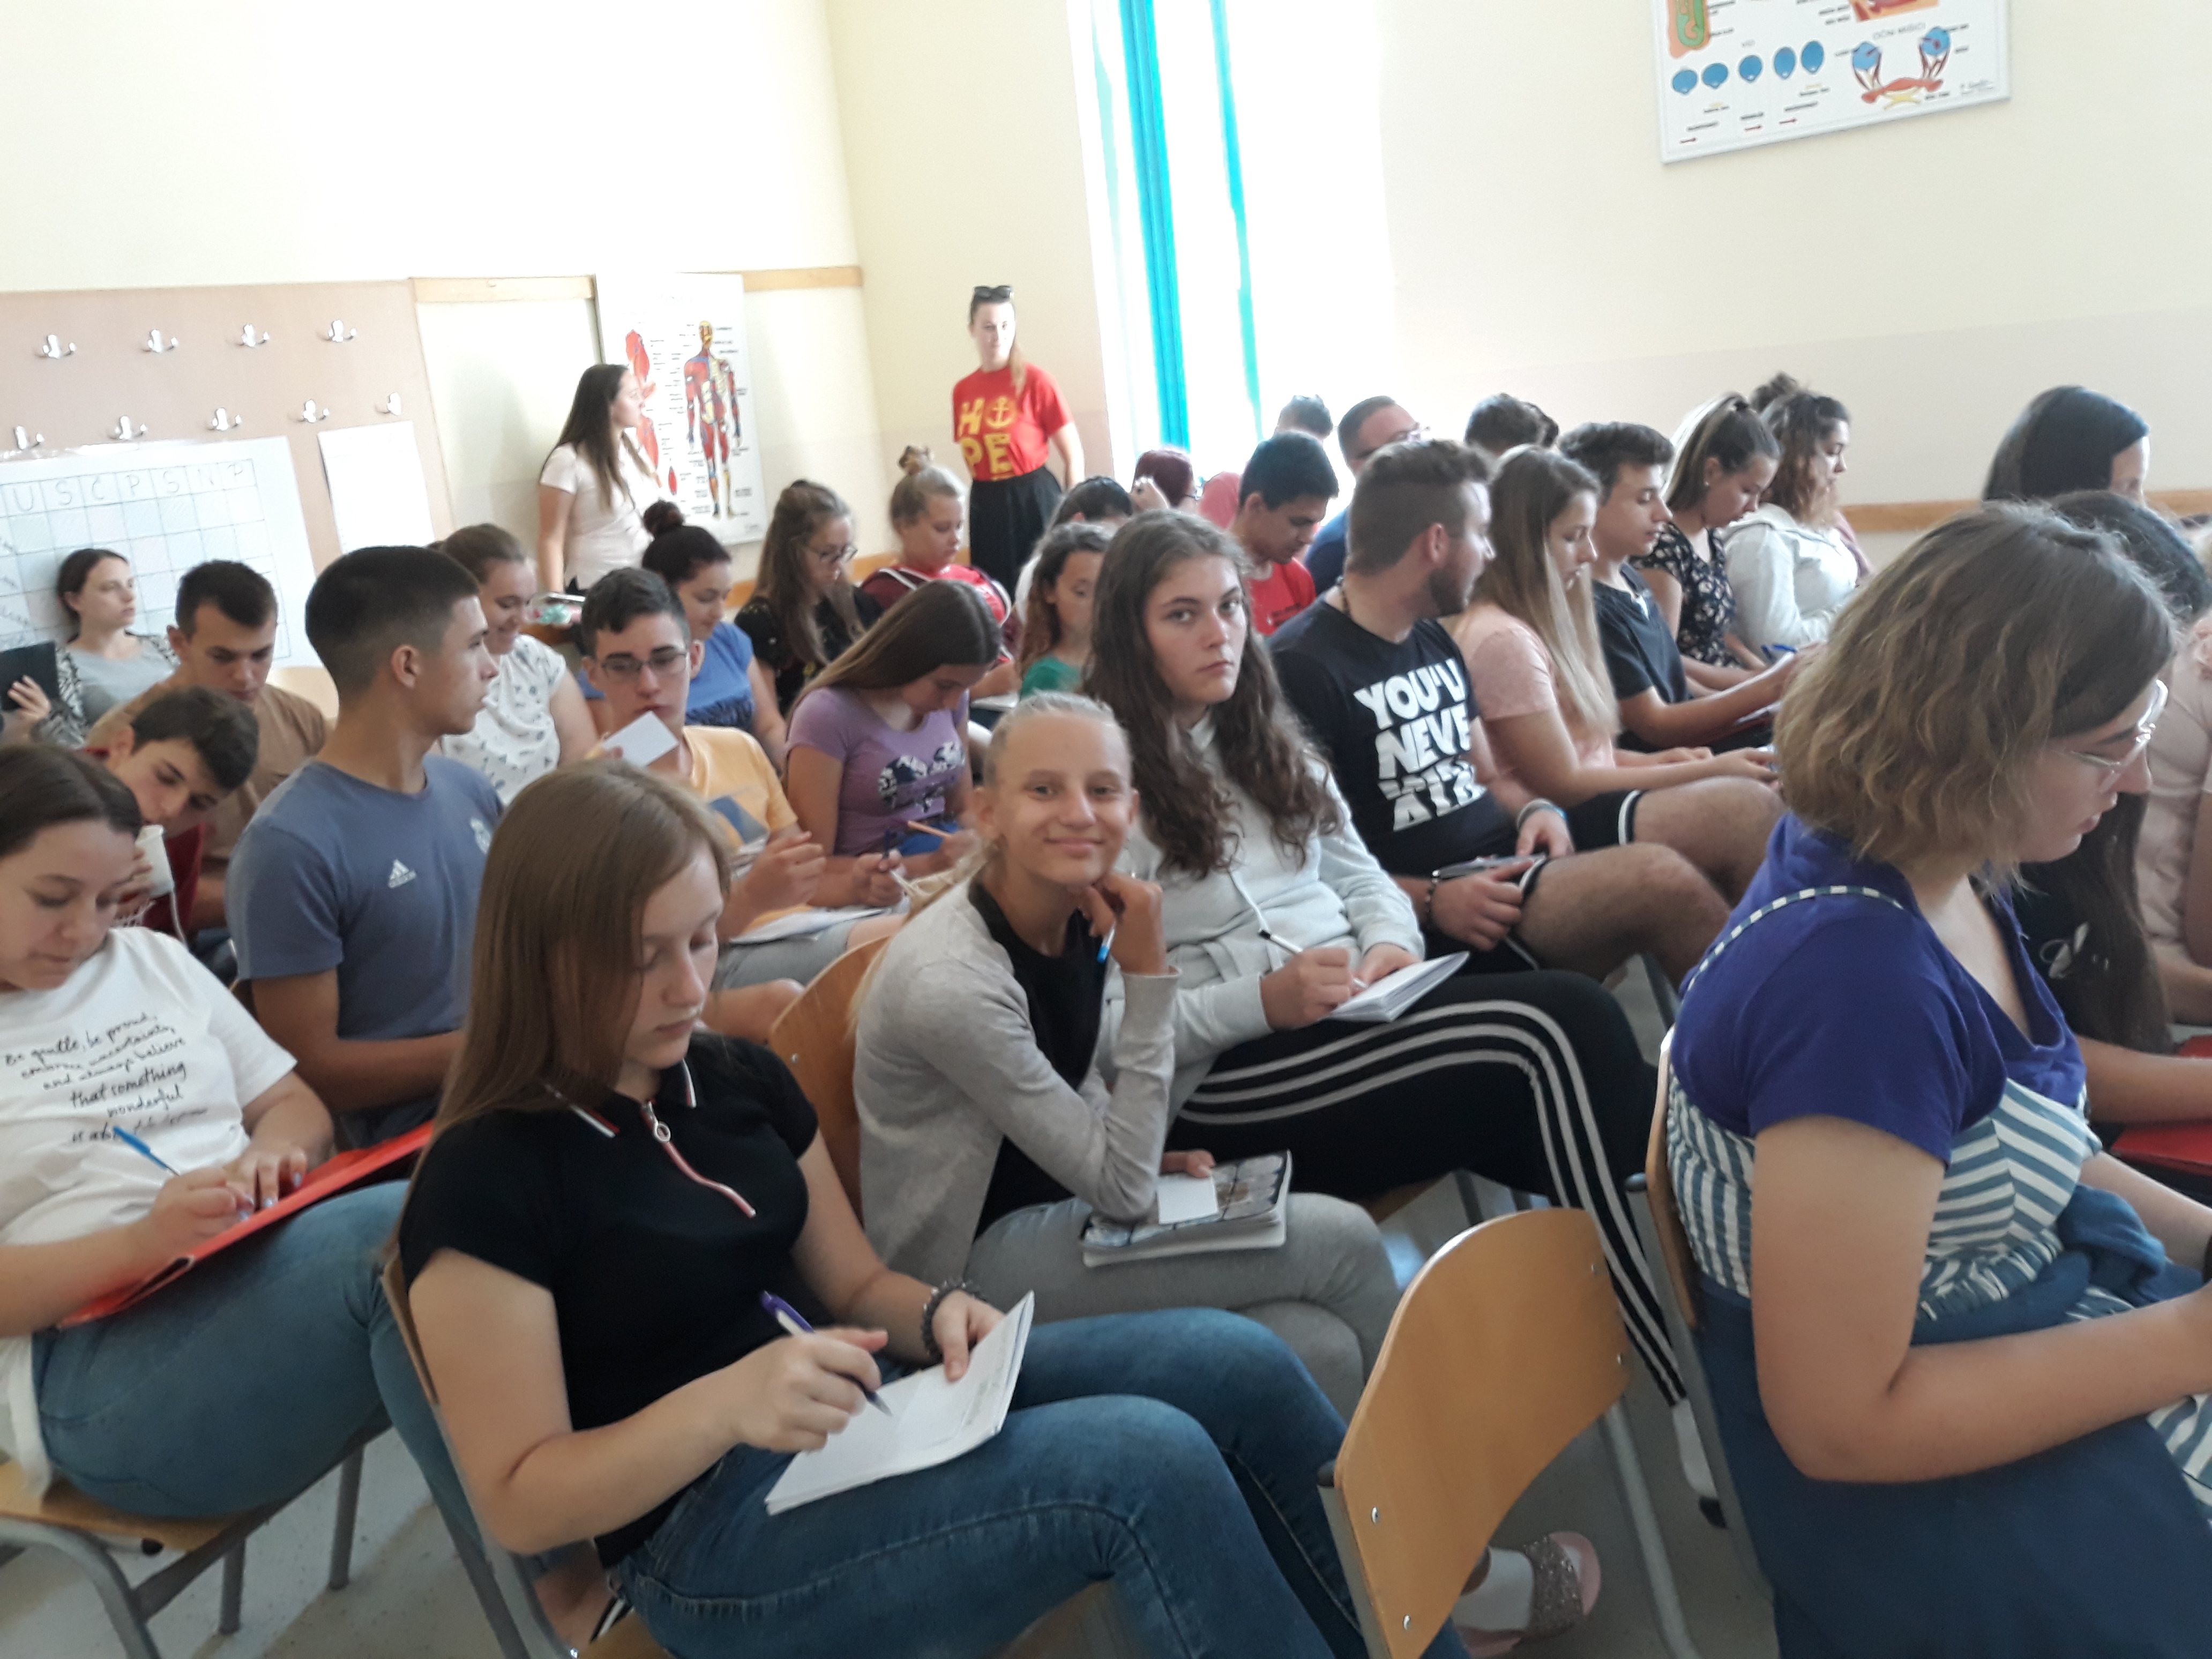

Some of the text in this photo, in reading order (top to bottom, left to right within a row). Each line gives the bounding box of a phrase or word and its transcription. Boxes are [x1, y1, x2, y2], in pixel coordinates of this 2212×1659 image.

[1374, 703, 1471, 780] NEVE
[70, 1082, 108, 1108] that
[110, 1061, 186, 1097] something
